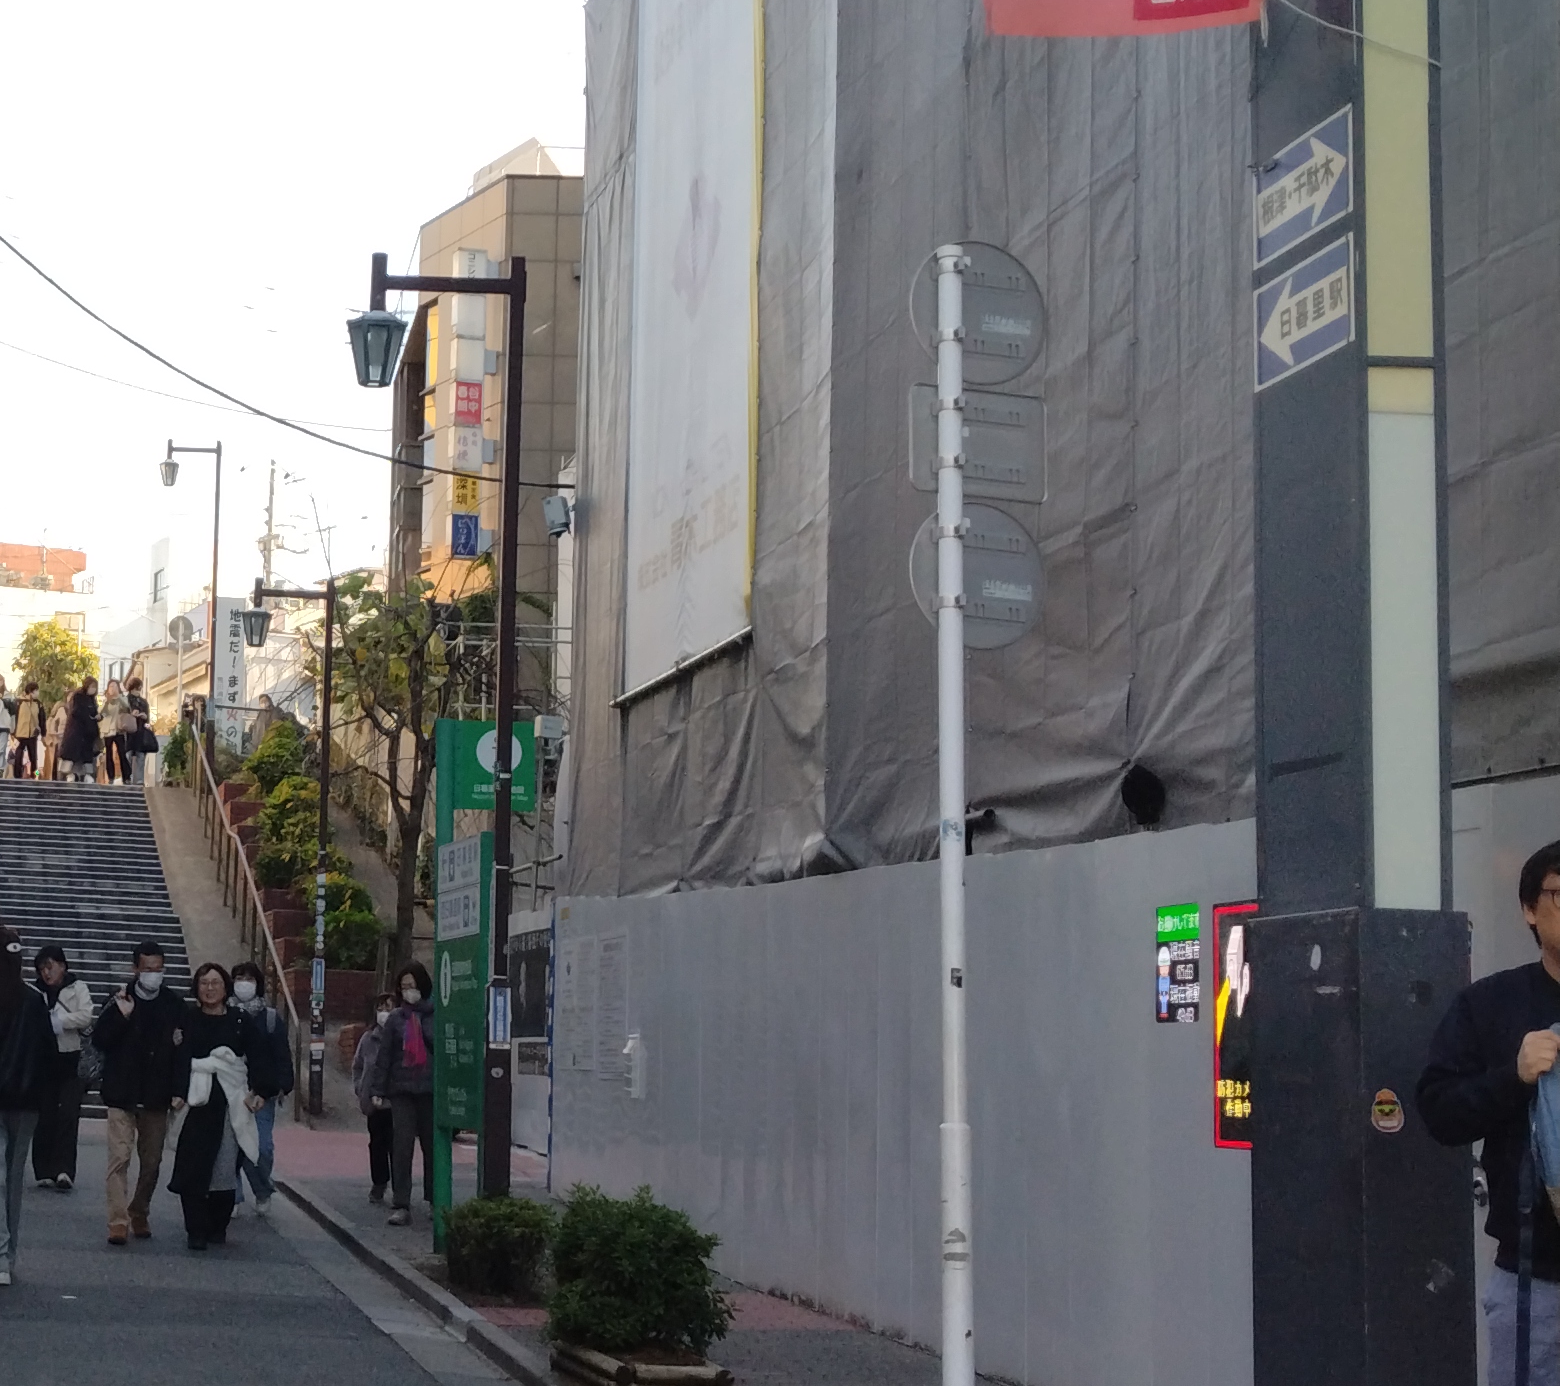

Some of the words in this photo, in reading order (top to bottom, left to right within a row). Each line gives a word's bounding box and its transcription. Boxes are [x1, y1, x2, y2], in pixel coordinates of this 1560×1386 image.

[1280, 275, 1344, 340] 日暮里駅
[1216, 1079, 1251, 1098] 防犯カメ
